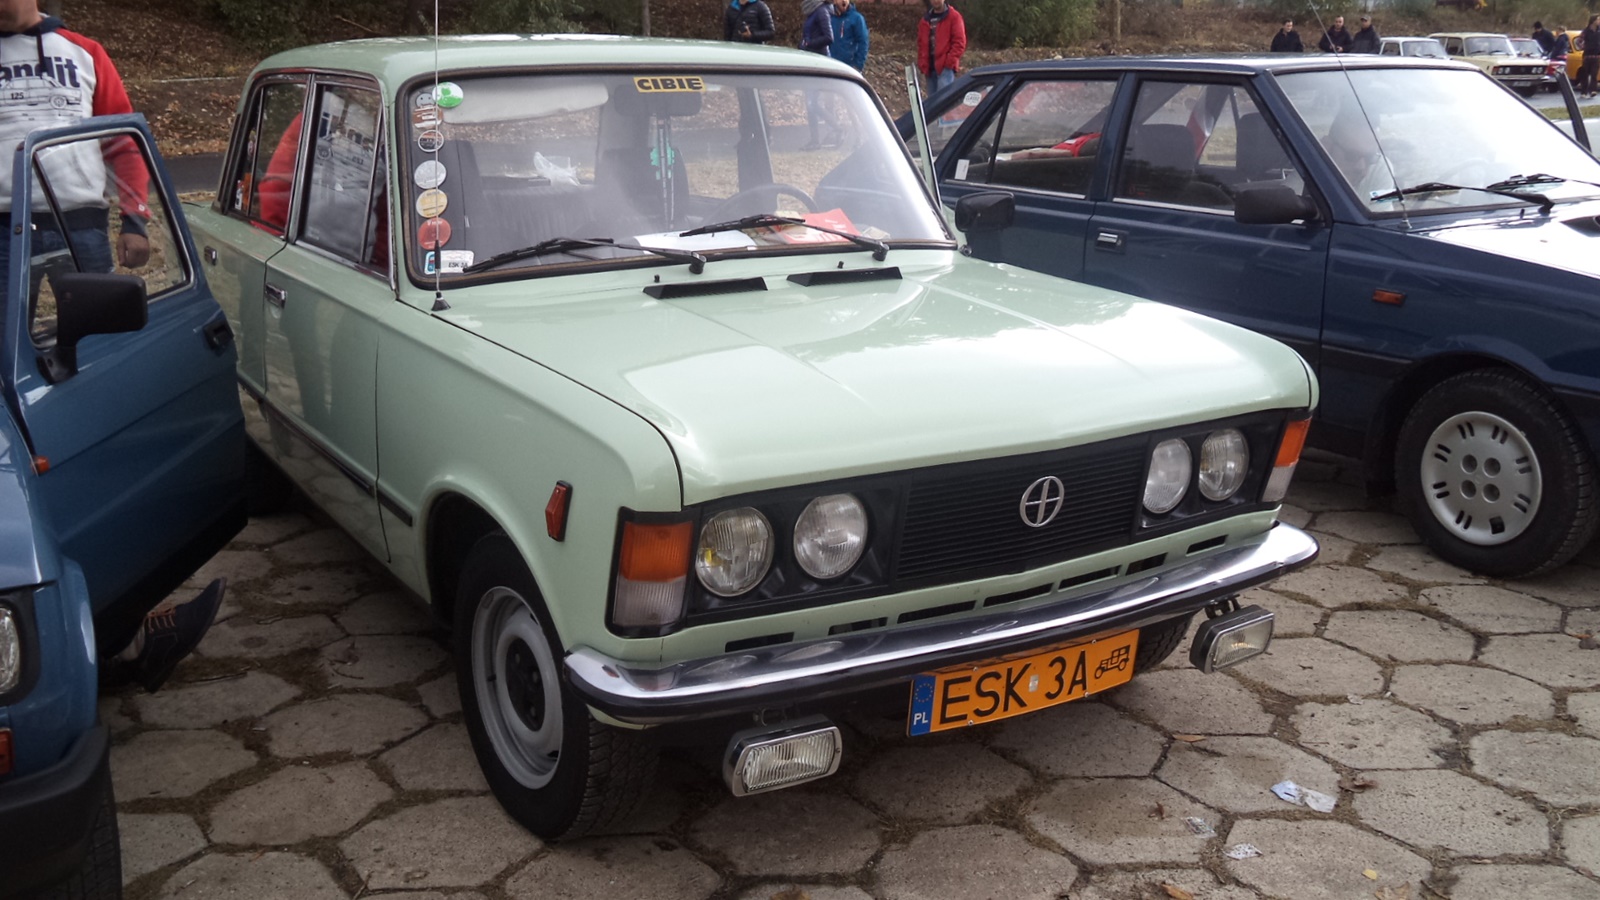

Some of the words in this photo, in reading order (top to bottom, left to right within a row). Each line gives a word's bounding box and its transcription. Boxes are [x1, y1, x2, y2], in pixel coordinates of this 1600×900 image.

[637, 78, 703, 90] CIBIE
[11, 92, 24, 100] 125
[940, 663, 1031, 724] ESK
[1045, 650, 1087, 700] 3A
[913, 712, 928, 726] PL
